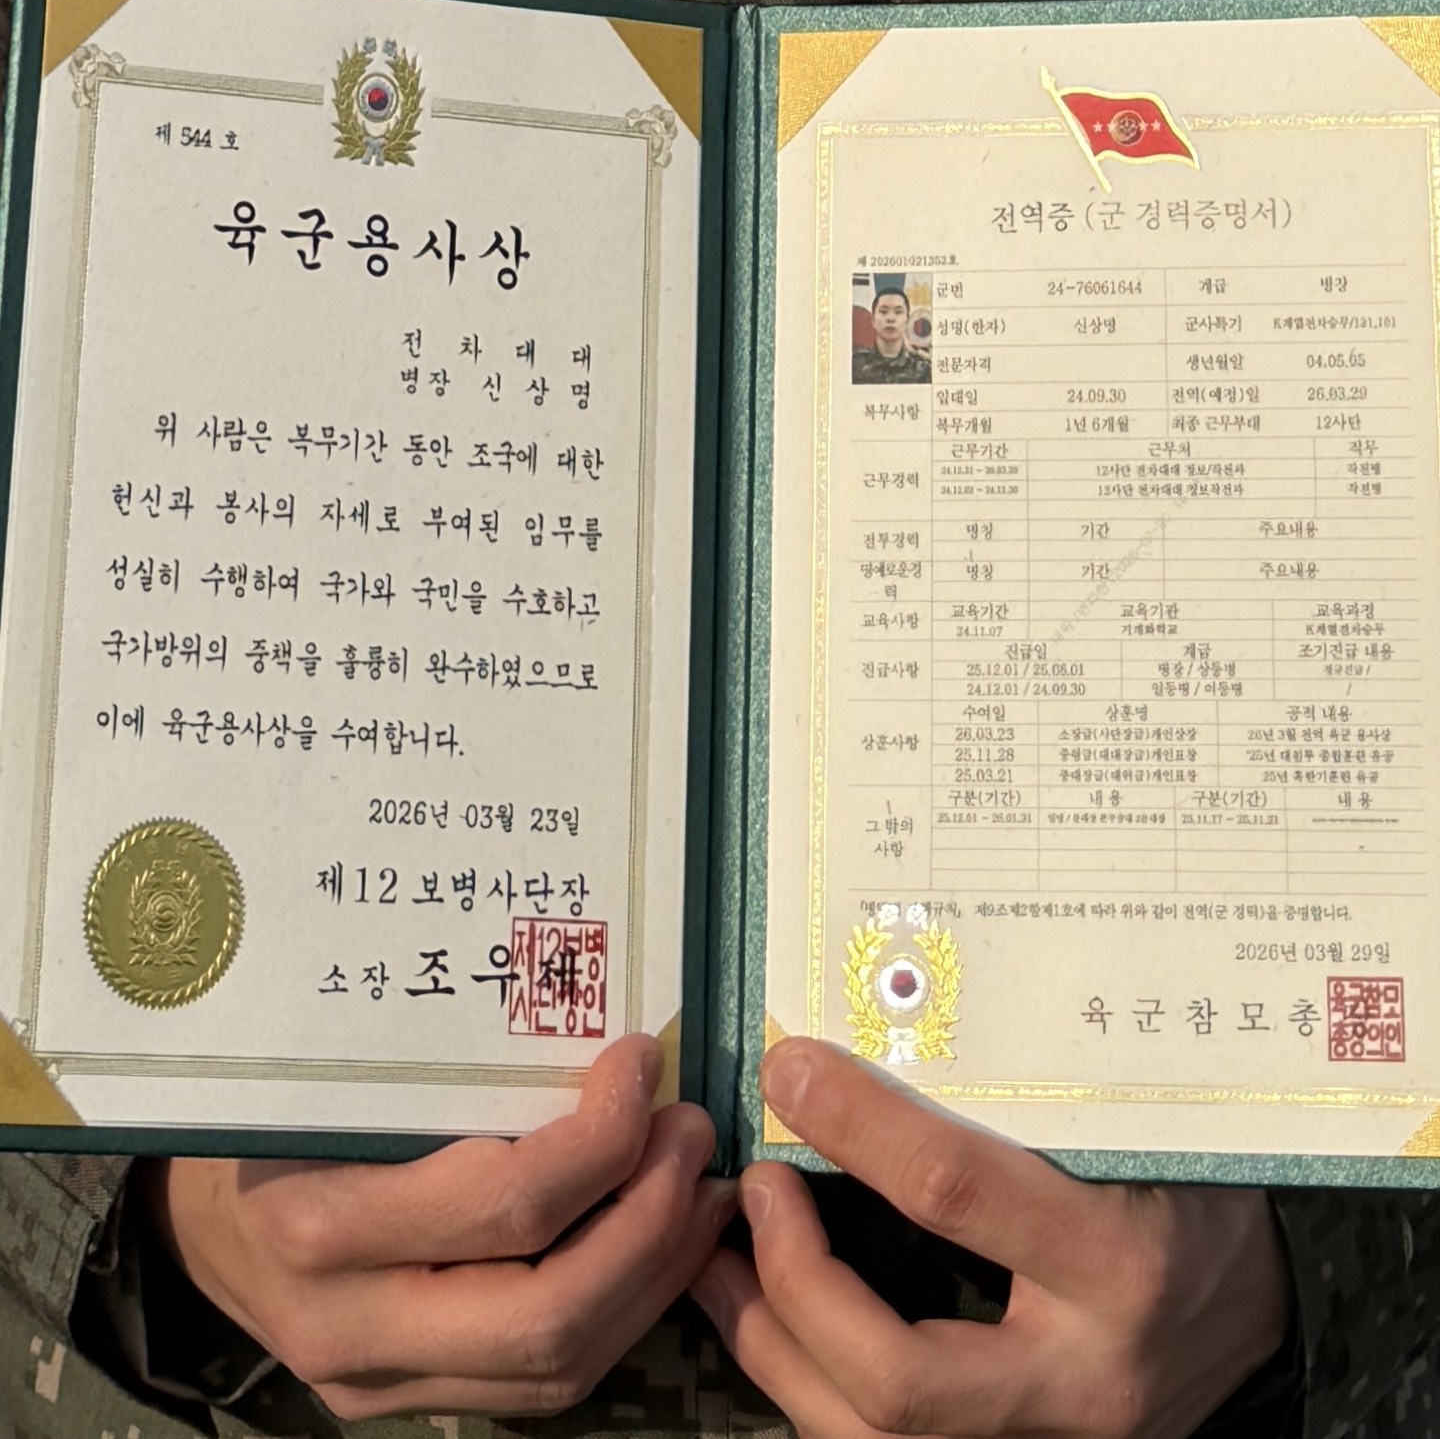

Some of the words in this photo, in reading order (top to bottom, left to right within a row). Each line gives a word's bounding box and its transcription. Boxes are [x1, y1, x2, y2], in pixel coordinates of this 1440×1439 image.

[154, 124, 172, 148] 제
[179, 128, 212, 150] 544
[221, 131, 239, 151] 호
[991, 201, 1075, 233] 전역증
[1136, 198, 1292, 231] 경력증명서)
[213, 200, 531, 291] 육군용사상
[1199, 278, 1227, 294] 계급
[936, 319, 1006, 336] 성명(한자)
[1074, 318, 1117, 334] 신상명
[1185, 316, 1242, 332] 군사특기
[937, 356, 991, 372] 전문자격
[1187, 355, 1244, 371] 생년월일
[400, 370, 452, 397] 병장
[937, 389, 978, 406] 입대일
[1067, 389, 1126, 403] 24.09.30
[1172, 386, 1259, 403] 전역(예정)일
[863, 404, 920, 420] 복무사항
[1065, 418, 1087, 432] 1년
[1092, 416, 1129, 432] 6개월
[1205, 416, 1260, 432] 근무부대
[1316, 416, 1361, 430] 12사단
[154, 414, 178, 448] 위
[197, 418, 272, 453] 사람은
[288, 423, 388, 461] 복무기간
[403, 434, 453, 469] 동안
[467, 439, 538, 476] 조국에
[557, 444, 604, 482] 대한
[951, 444, 1008, 458] 근무기간
[1149, 441, 1191, 457] 근무처
[1349, 440, 1378, 456] 직무
[112, 483, 194, 513] 헌신과
[216, 491, 297, 528] 봉사의
[320, 497, 400, 536] 자세로
[422, 508, 500, 545] 부여된
[525, 514, 603, 551] 임무를
[966, 523, 994, 540] 명칭
[1081, 522, 1110, 540] 기간
[1259, 522, 1318, 538] 주요내용
[966, 564, 994, 580] 명칭
[1082, 563, 1110, 580] 기간
[1259, 563, 1319, 579] 주요내용
[104, 556, 180, 592] 성실히
[201, 563, 299, 602] 수행하여
[320, 572, 395, 608] 국가와
[412, 577, 488, 614] 국민을
[502, 583, 600, 622] 수호하고
[862, 614, 919, 629] 교육사항
[951, 605, 1009, 620] 교육기간
[1121, 603, 1179, 619] 교육기관
[1316, 603, 1375, 618] 교육과정
[102, 632, 227, 670] 국가방위의
[245, 640, 322, 677] 중책을
[335, 643, 408, 682] 훌륭히
[425, 649, 599, 691] 완수하였으므로
[862, 662, 919, 679] 진급사항
[1005, 643, 1047, 660] 진급일
[1183, 643, 1211, 659] 계급
[1299, 643, 1359, 660] 조기진급
[1365, 643, 1394, 660] 내용
[963, 705, 1006, 721] 수여일
[1286, 706, 1315, 721] 공적
[1323, 705, 1351, 721] 내용
[97, 704, 144, 741] 이에
[162, 709, 318, 751] 육군용사상을
[331, 719, 465, 757] 수여합니다.
[949, 790, 1021, 807] 구분(기간)
[1193, 790, 1267, 808] 구분(기간)
[368, 798, 449, 830] 2026년
[463, 801, 516, 834] 03월
[530, 806, 580, 837] 23일
[874, 841, 904, 857] 사항
[413, 868, 590, 920] 보병사단장
[1236, 943, 1297, 963] 2026년
[1305, 943, 1343, 963] 03월
[1351, 942, 1390, 963] 29일
[318, 964, 390, 1000] 소장
